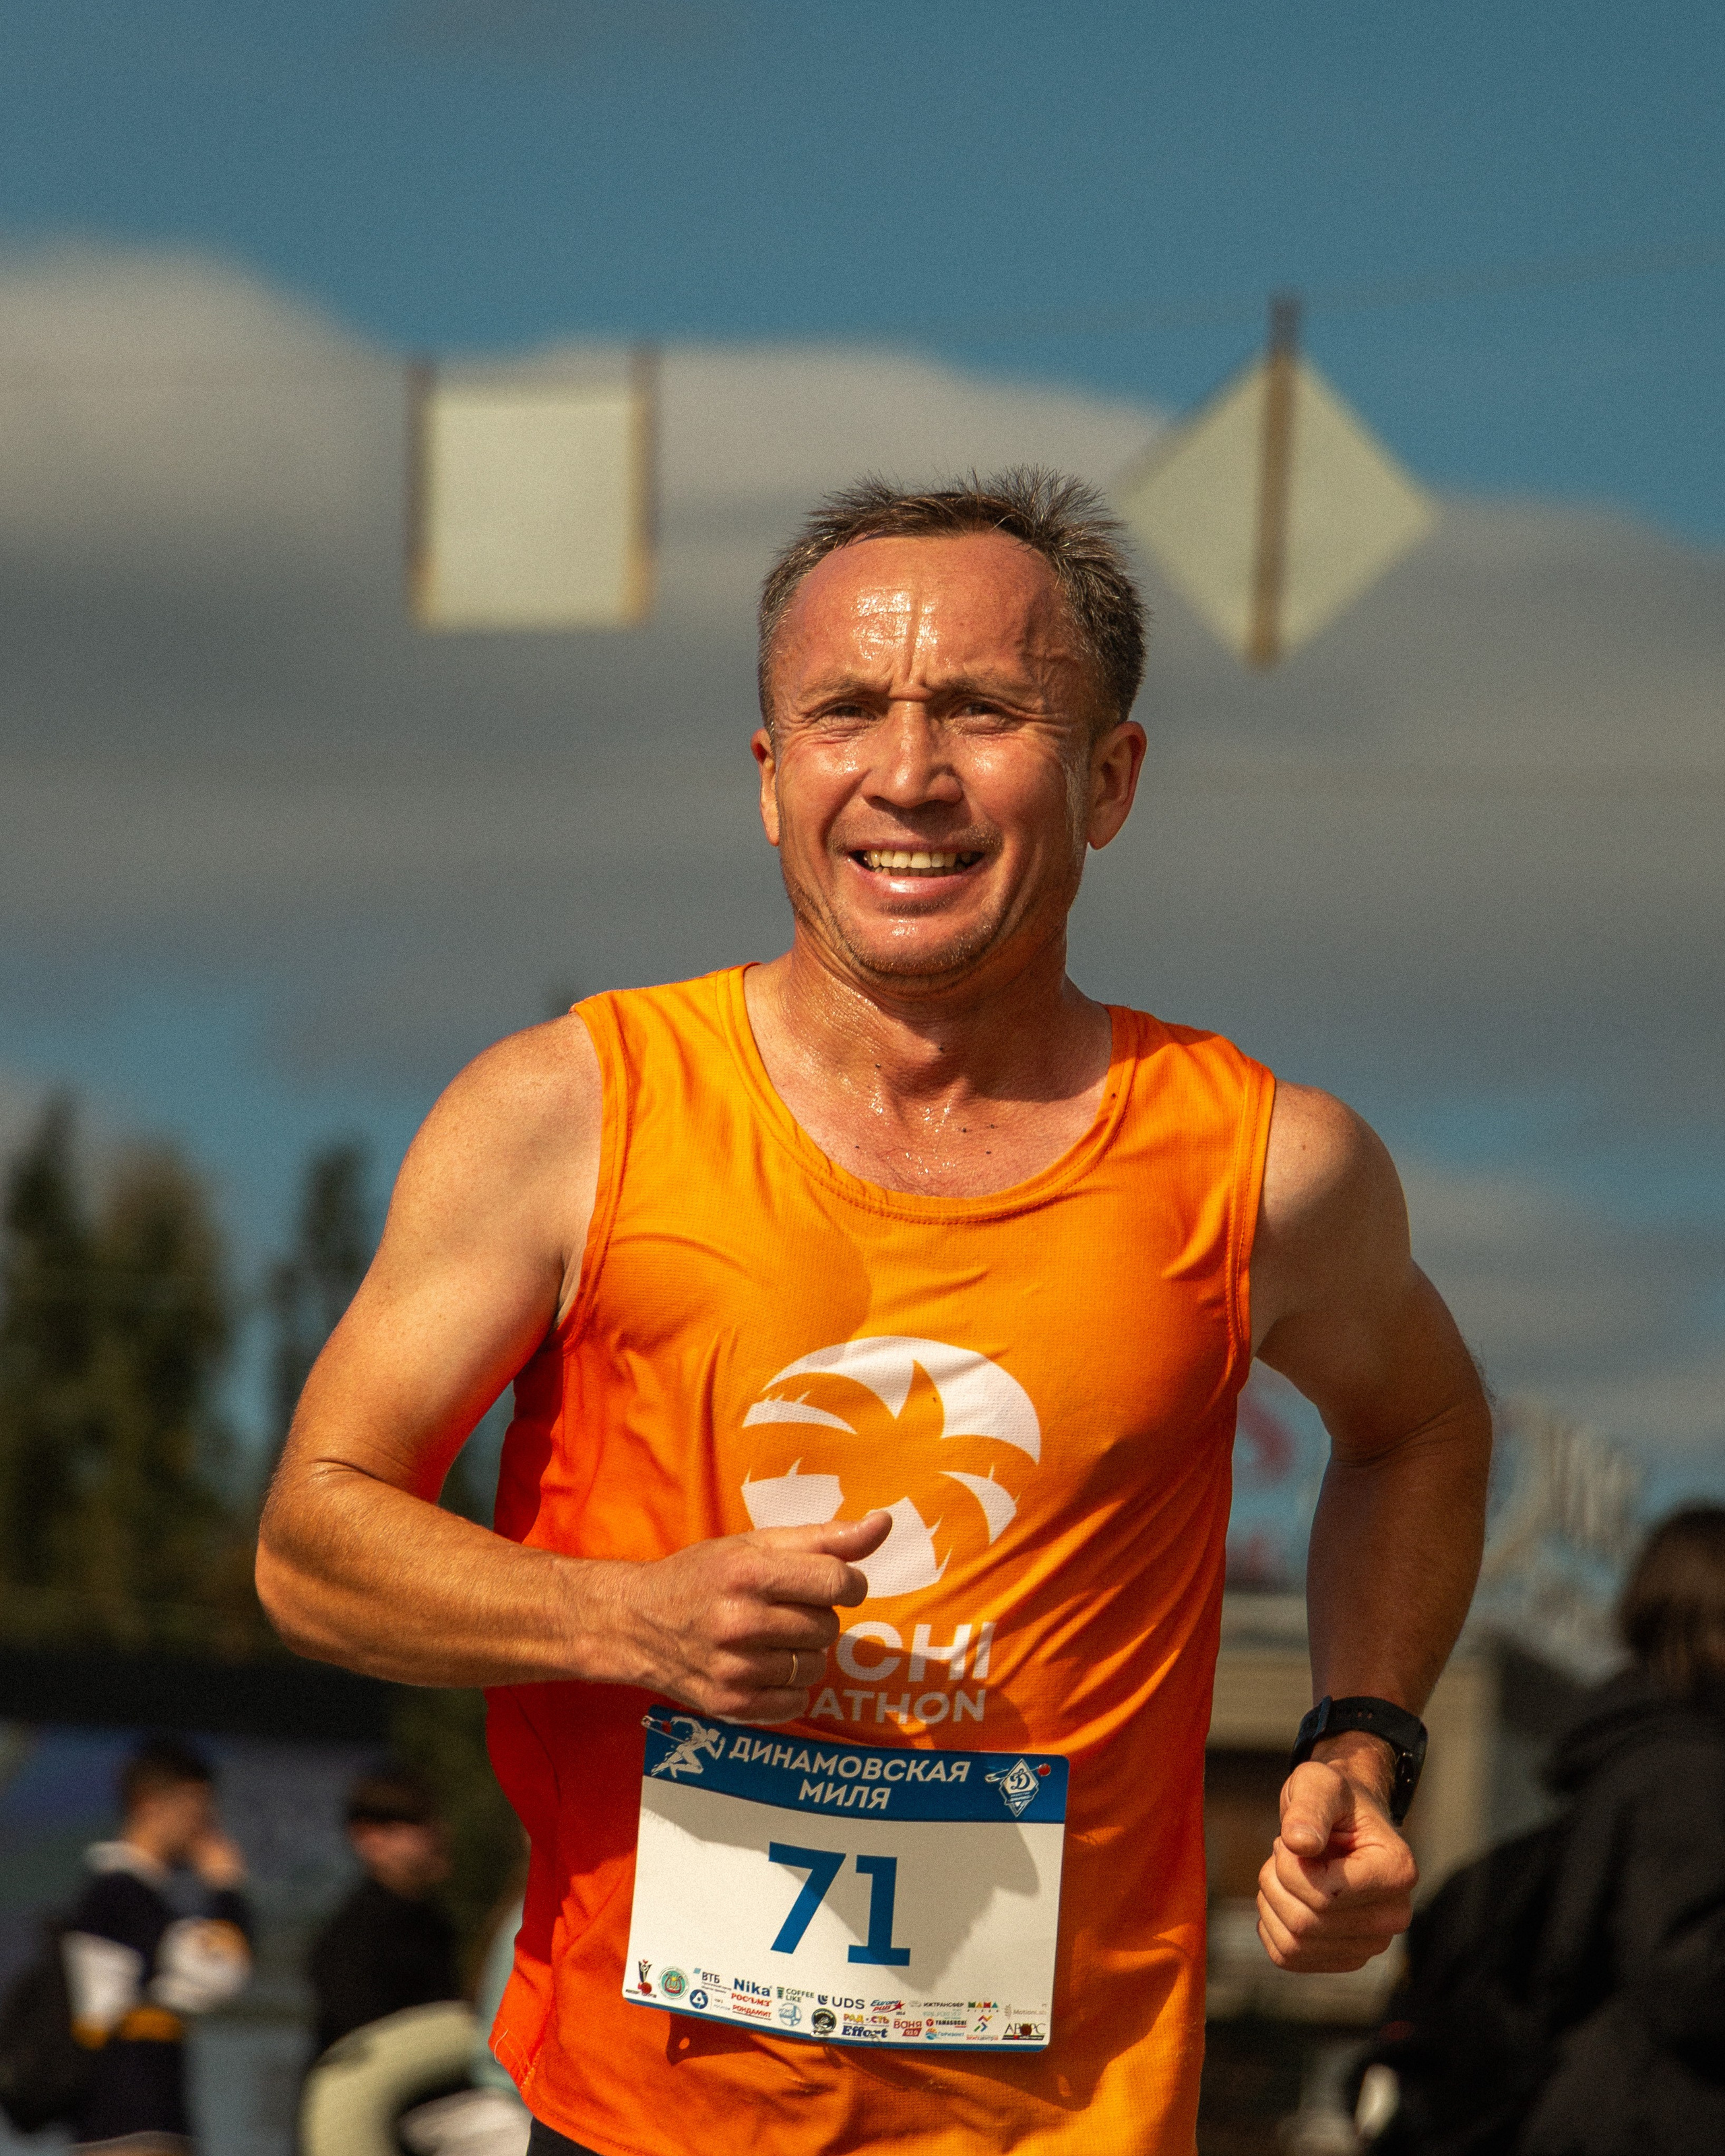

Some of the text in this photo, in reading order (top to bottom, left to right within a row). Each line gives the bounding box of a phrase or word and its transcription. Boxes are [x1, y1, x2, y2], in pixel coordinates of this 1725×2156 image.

[823, 1620, 997, 1682] CHI
[809, 1687, 986, 1724] ATHON
[728, 1736, 971, 1782] ДИНАМОВСКАЯ
[798, 1779, 891, 1810] МИЛЯ
[768, 1841, 911, 1966] 71
[702, 1971, 720, 1984] ВТБ
[734, 1977, 770, 1997] Nika
[786, 1988, 815, 1998] COFFEE
[786, 1995, 802, 2003] LIKE
[832, 1996, 865, 2010] UDS
[842, 2025, 888, 2038] Effort
